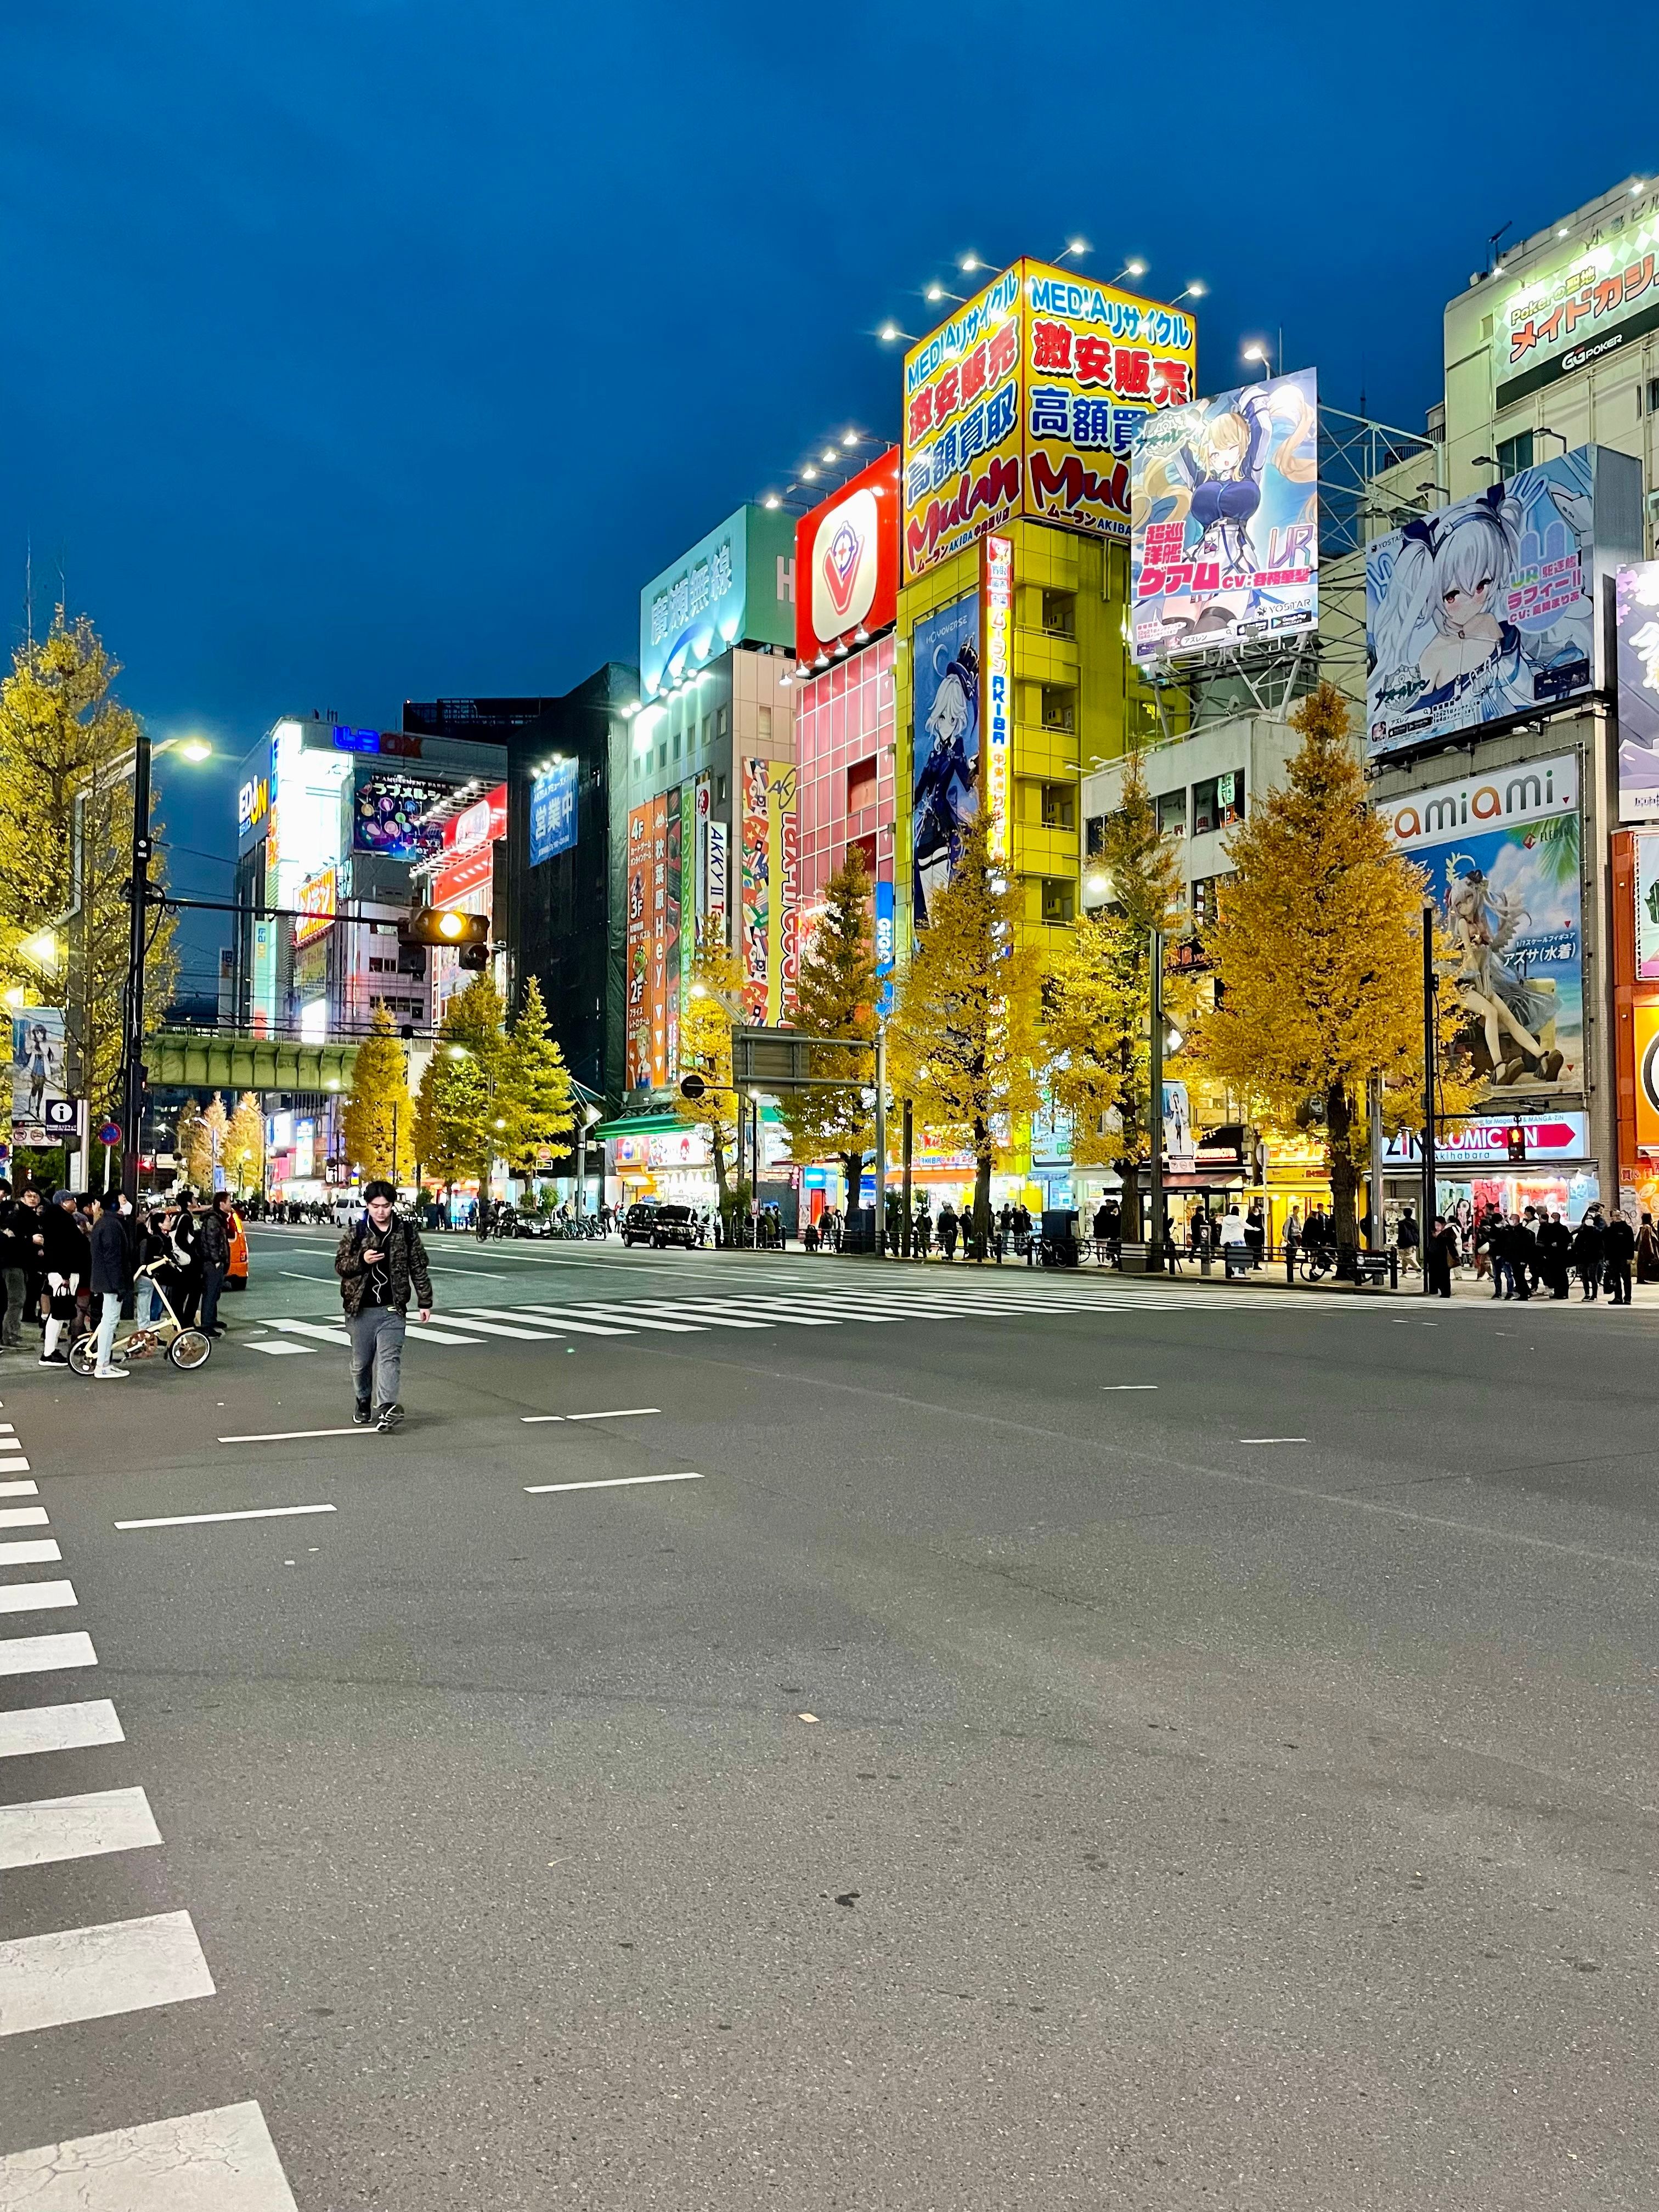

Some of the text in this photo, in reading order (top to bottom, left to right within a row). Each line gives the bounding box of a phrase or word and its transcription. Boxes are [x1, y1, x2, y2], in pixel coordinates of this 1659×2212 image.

[1510, 253, 1659, 363] メイドカジ
[909, 318, 1015, 444] 激安販売
[1034, 320, 1188, 405] 激安販売
[909, 385, 1013, 505] 高額買取
[1032, 388, 1144, 450] 高額買
[1030, 452, 1132, 509] Mul
[907, 458, 1019, 572] Mulan
[1047, 504, 1097, 526] ムーラン
[917, 546, 948, 573] ムーラン
[949, 531, 973, 553] AKIBA
[1268, 525, 1313, 569] UR
[1138, 563, 1220, 596] グアム
[1184, 635, 1207, 644] アズレン
[992, 676, 1005, 744] AKIBA
[535, 790, 573, 840] 営業中
[631, 817, 644, 840] 4F
[1395, 770, 1553, 838] amiami
[631, 895, 644, 919] 3F
[656, 916, 664, 988] Hey
[1504, 943, 1576, 967] アズサ(水着)
[630, 980, 642, 1004] 2F
